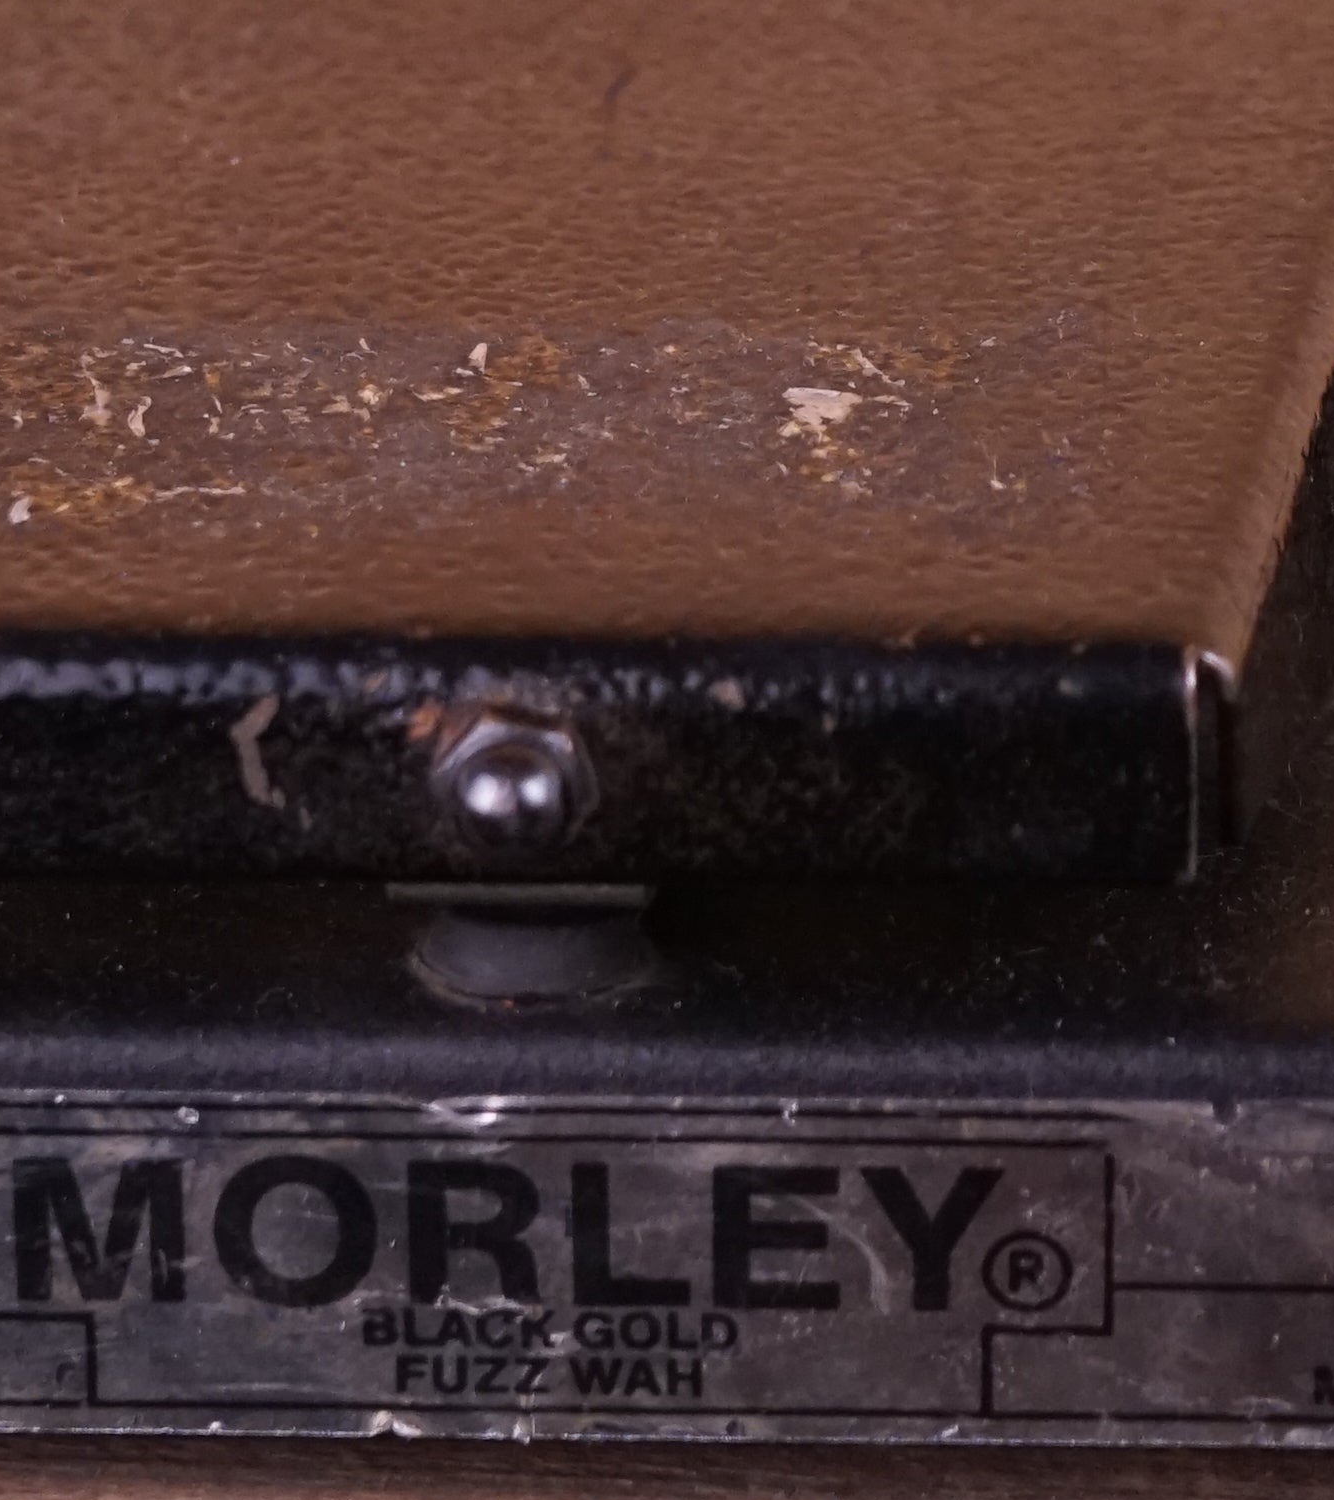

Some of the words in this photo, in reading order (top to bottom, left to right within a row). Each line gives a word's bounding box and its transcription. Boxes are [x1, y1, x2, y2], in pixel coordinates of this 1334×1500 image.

[362, 1306, 556, 1348] BLACK
[573, 1310, 739, 1351] GOLD
[395, 1353, 551, 1393] FUZZ
[569, 1356, 703, 1397] WAH
